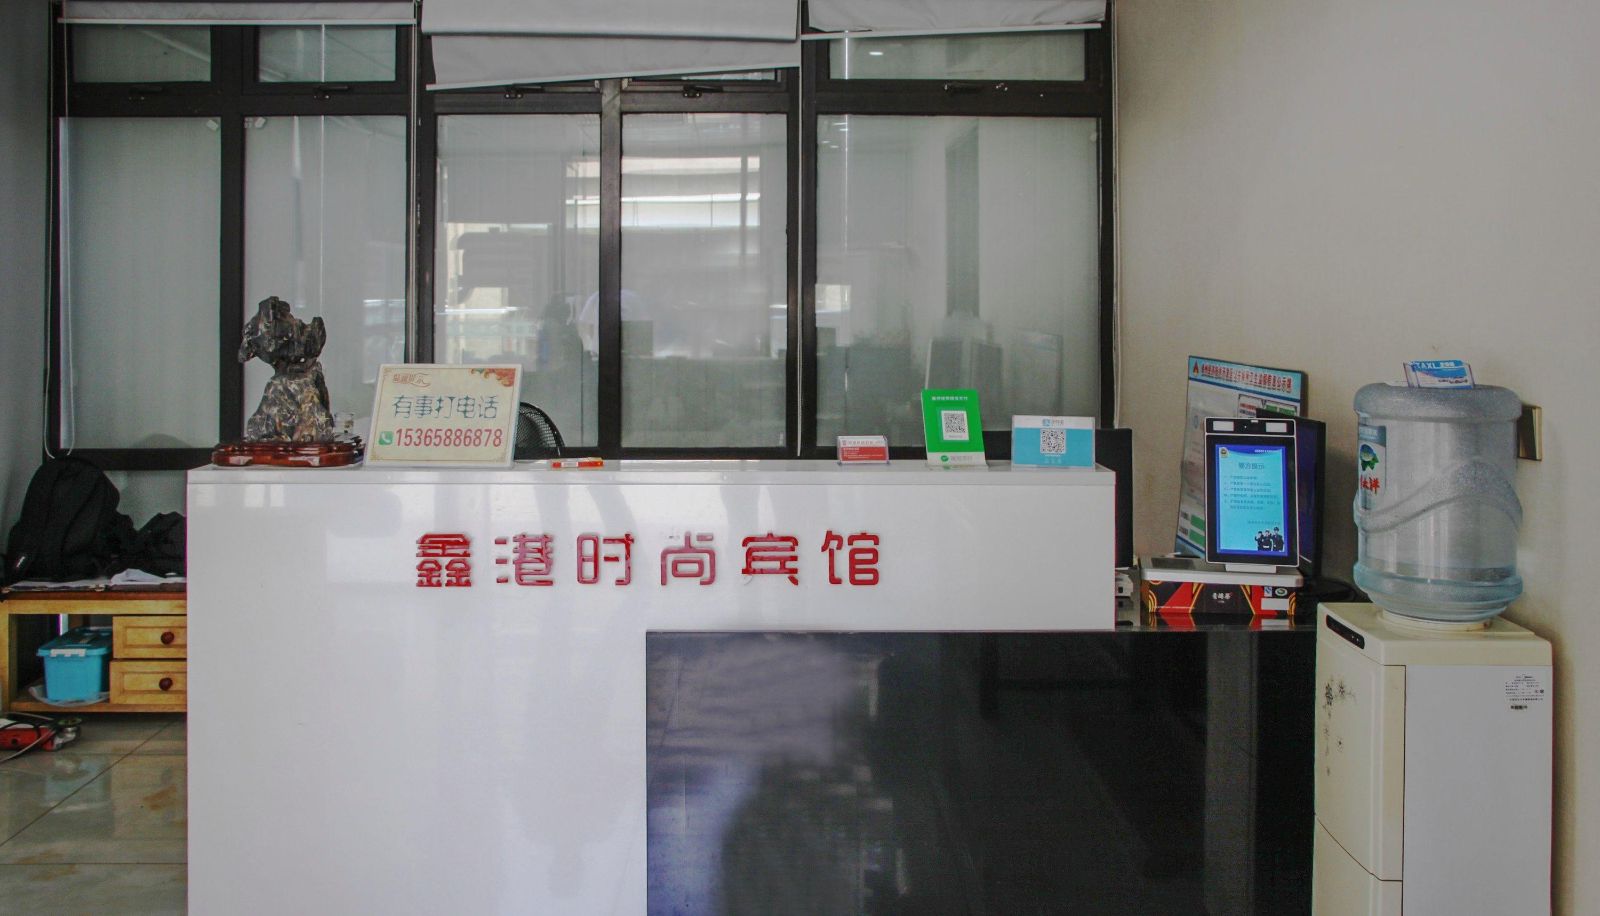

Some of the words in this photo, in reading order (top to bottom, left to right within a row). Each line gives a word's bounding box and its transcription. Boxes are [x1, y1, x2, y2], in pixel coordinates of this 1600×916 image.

[392, 394, 499, 419] 有事打电话
[395, 428, 503, 448] 15365886878
[415, 530, 881, 588] 鑫港时尚宾馆
